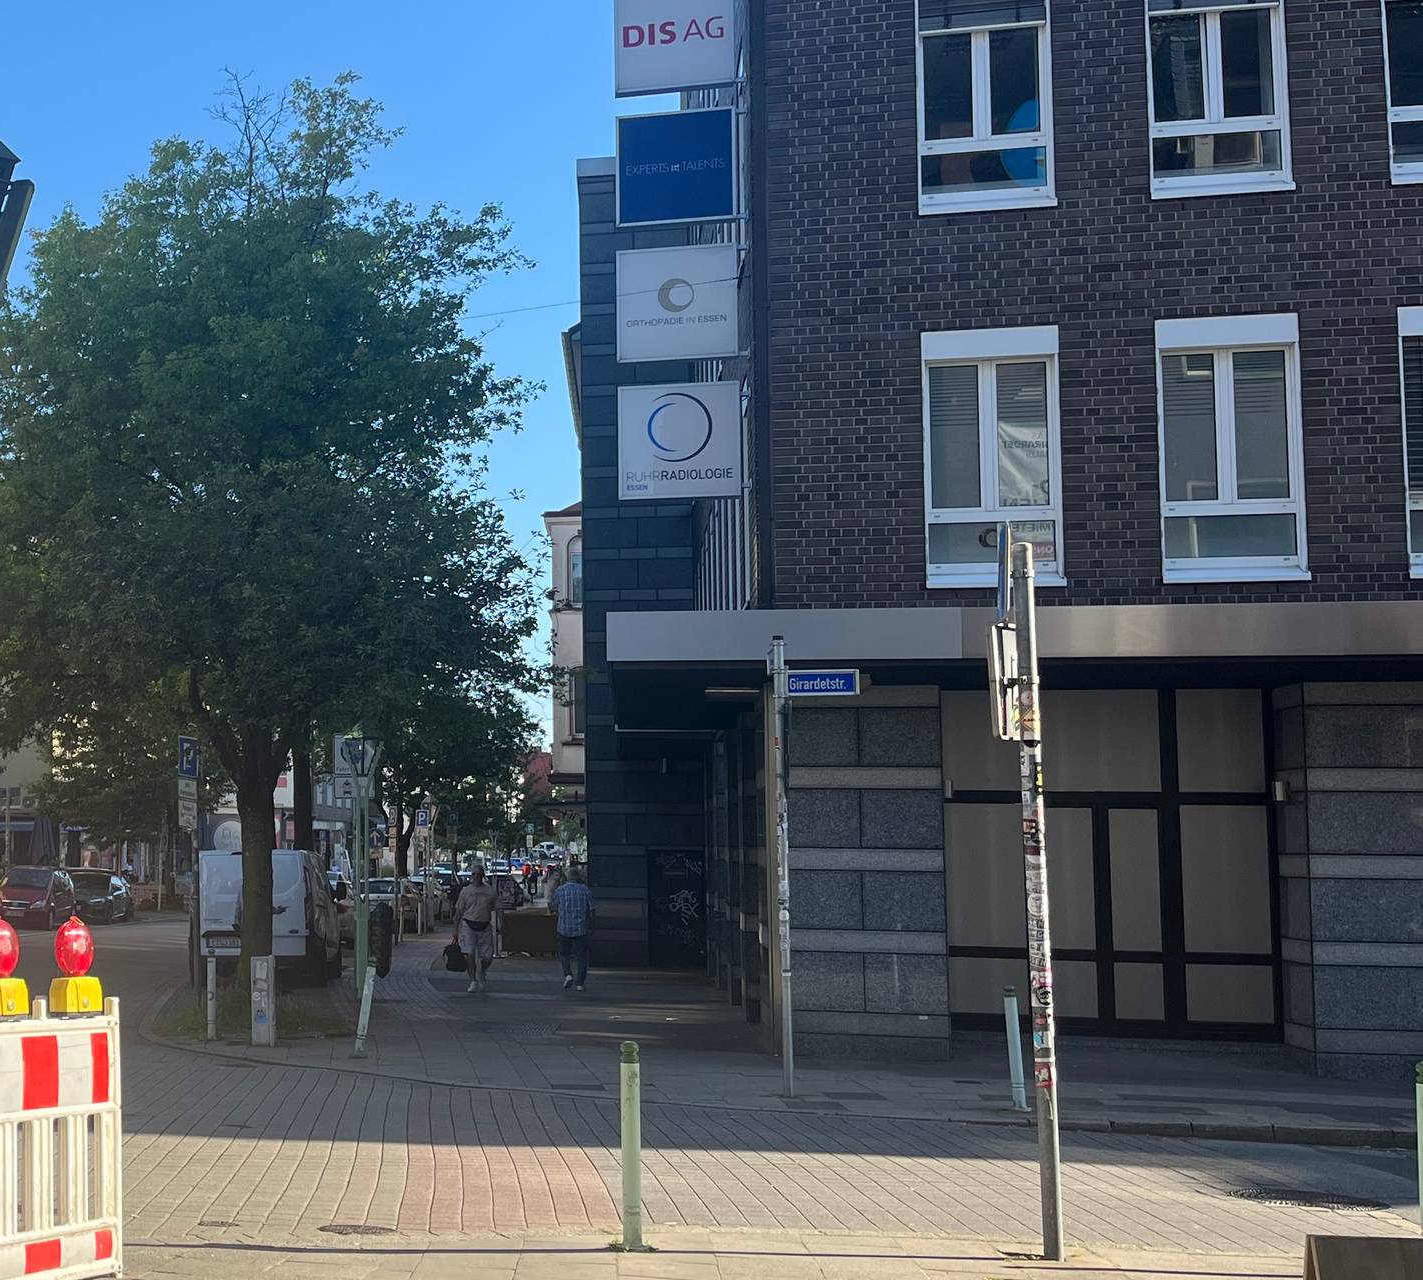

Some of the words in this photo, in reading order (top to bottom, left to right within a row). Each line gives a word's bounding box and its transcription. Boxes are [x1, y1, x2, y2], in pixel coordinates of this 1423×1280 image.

[622, 20, 677, 48] DIS
[682, 15, 725, 42] AG
[624, 162, 670, 177] EXPERTS
[681, 157, 727, 171] TALENTS
[697, 313, 727, 323] ESSEN
[625, 467, 734, 483] RUHRRADIOLOGIE
[626, 484, 649, 492] ESSEN
[789, 676, 847, 691] Girardetstr.
